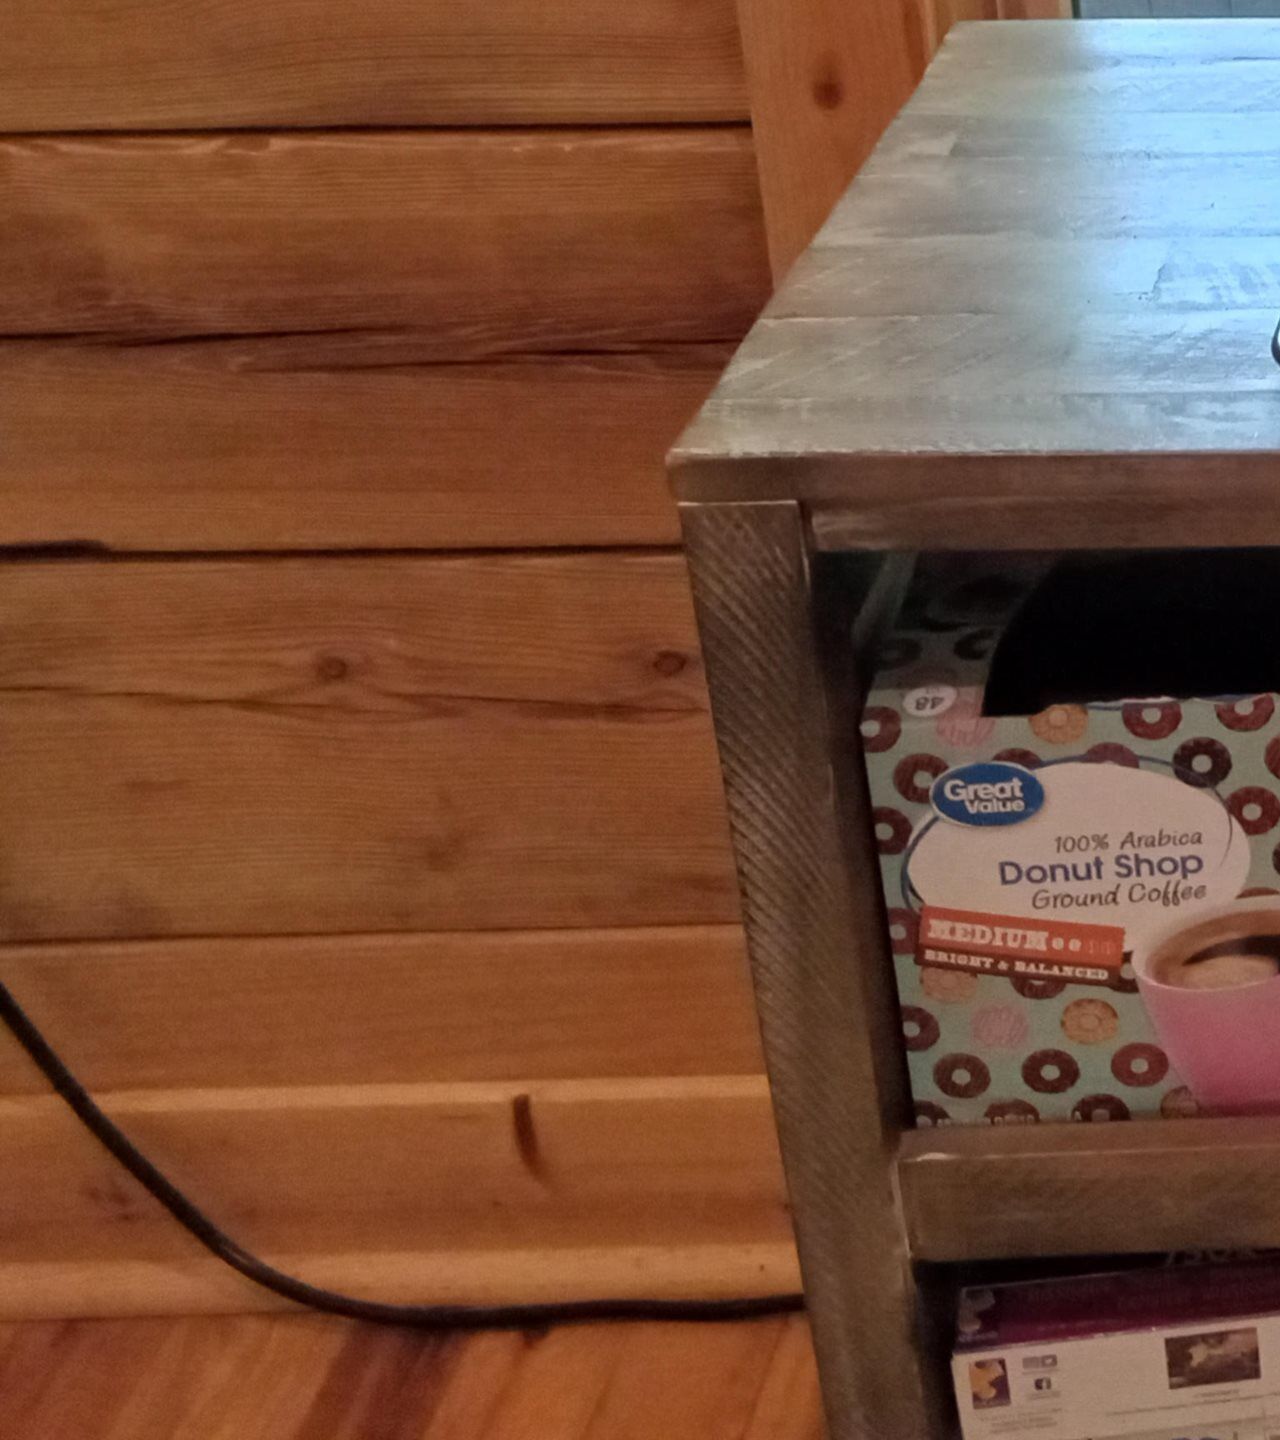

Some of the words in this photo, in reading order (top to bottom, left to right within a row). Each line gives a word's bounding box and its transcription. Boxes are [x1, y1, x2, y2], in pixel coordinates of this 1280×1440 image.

[944, 777, 1023, 801] Great
[964, 798, 1026, 814] Value
[1055, 833, 1110, 853] 100%
[1120, 829, 1204, 850] Arabica
[999, 856, 1104, 886] Donut
[1114, 853, 1204, 879] Shop
[1032, 883, 1121, 910] Ground
[1128, 880, 1208, 907] Coffee
[928, 919, 1050, 951] MEDIUM
[925, 949, 994, 966] BRIGHT
[1014, 960, 1109, 980] BALANCED
